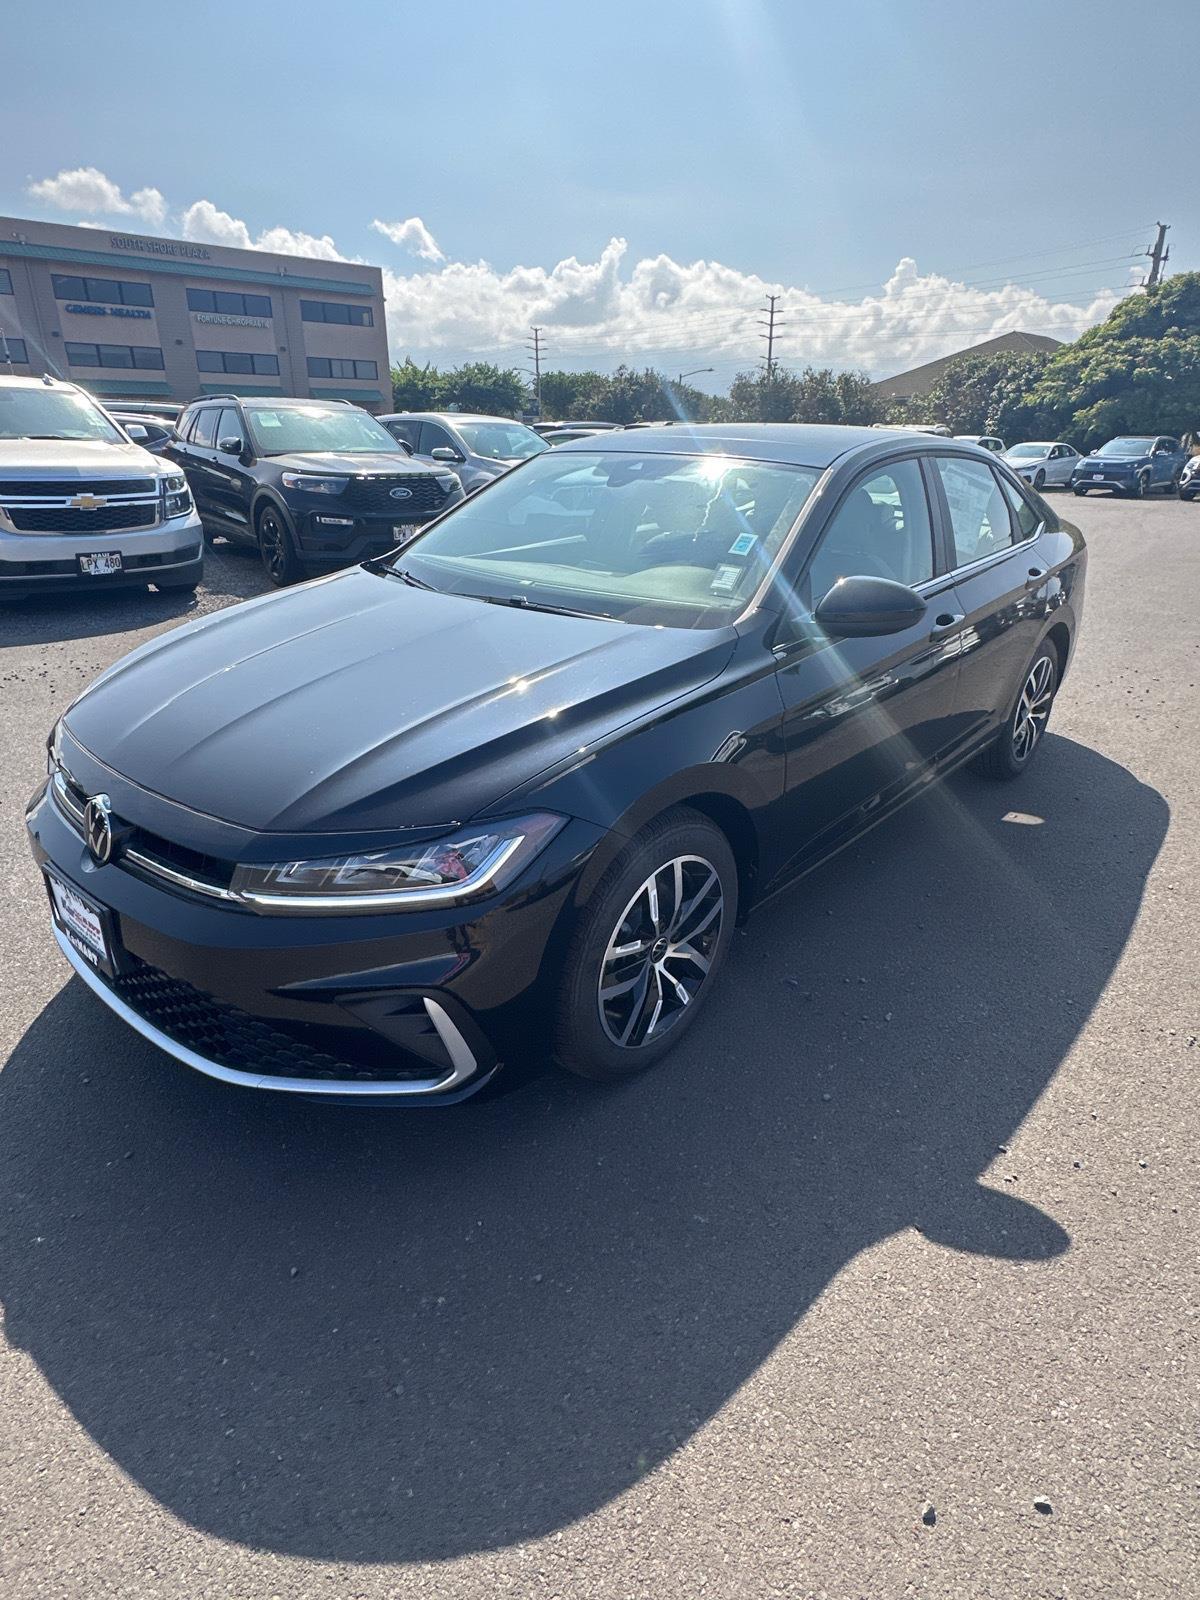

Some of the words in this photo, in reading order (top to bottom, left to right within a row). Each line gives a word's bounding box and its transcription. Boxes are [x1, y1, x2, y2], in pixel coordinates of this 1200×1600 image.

[110, 237, 144, 251] SOUTH
[147, 242, 178, 256] SHORE
[180, 246, 210, 260] PLAZA
[80, 559, 99, 571] LPX
[104, 556, 121, 569] 480
